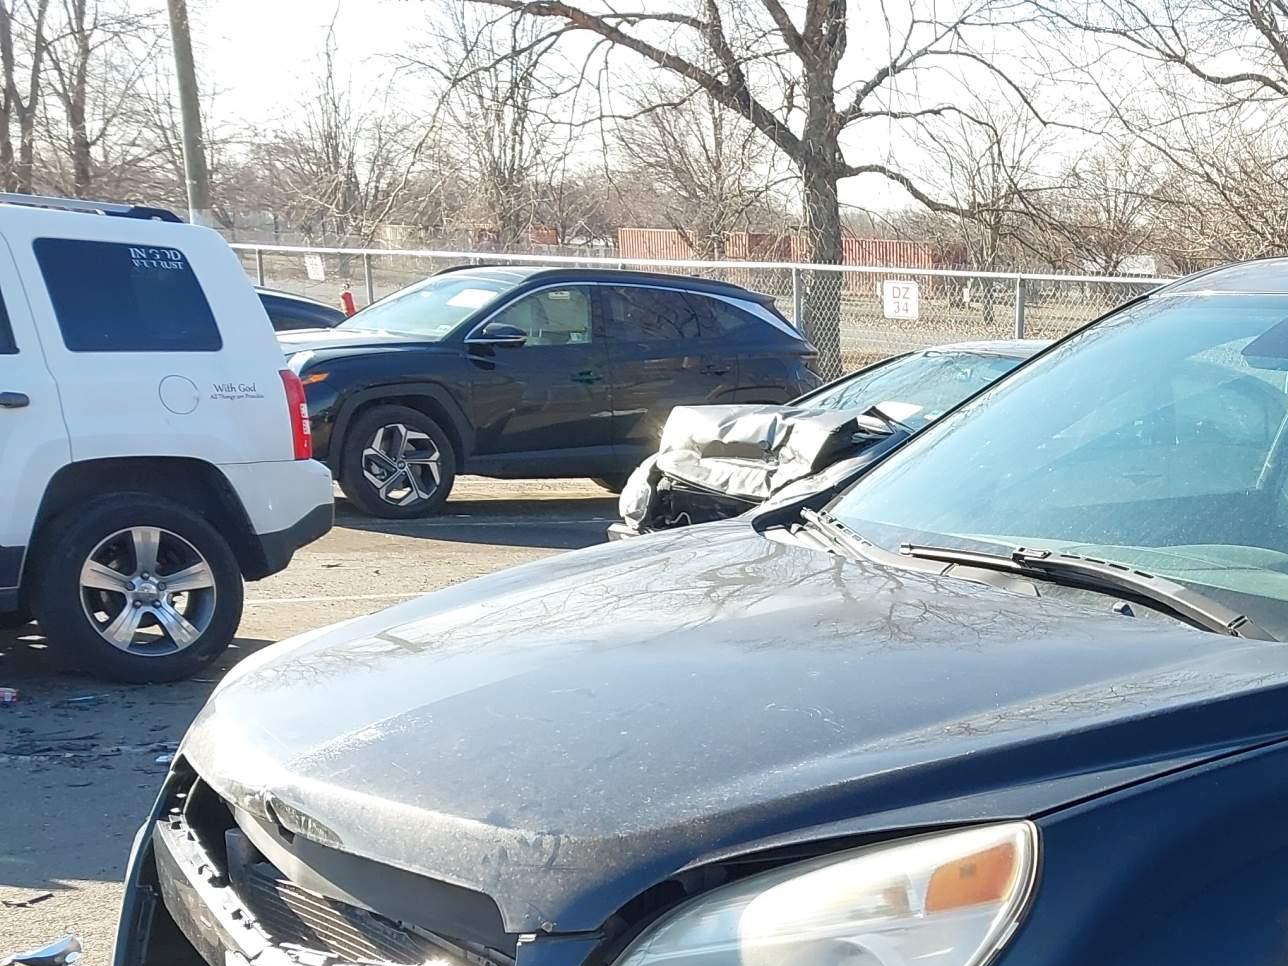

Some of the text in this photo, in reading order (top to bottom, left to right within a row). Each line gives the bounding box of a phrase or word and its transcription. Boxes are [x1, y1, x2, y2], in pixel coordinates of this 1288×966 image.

[129, 247, 147, 258] IN
[892, 286, 910, 300] DZ
[893, 301, 909, 314] 34
[212, 382, 256, 393] With God
